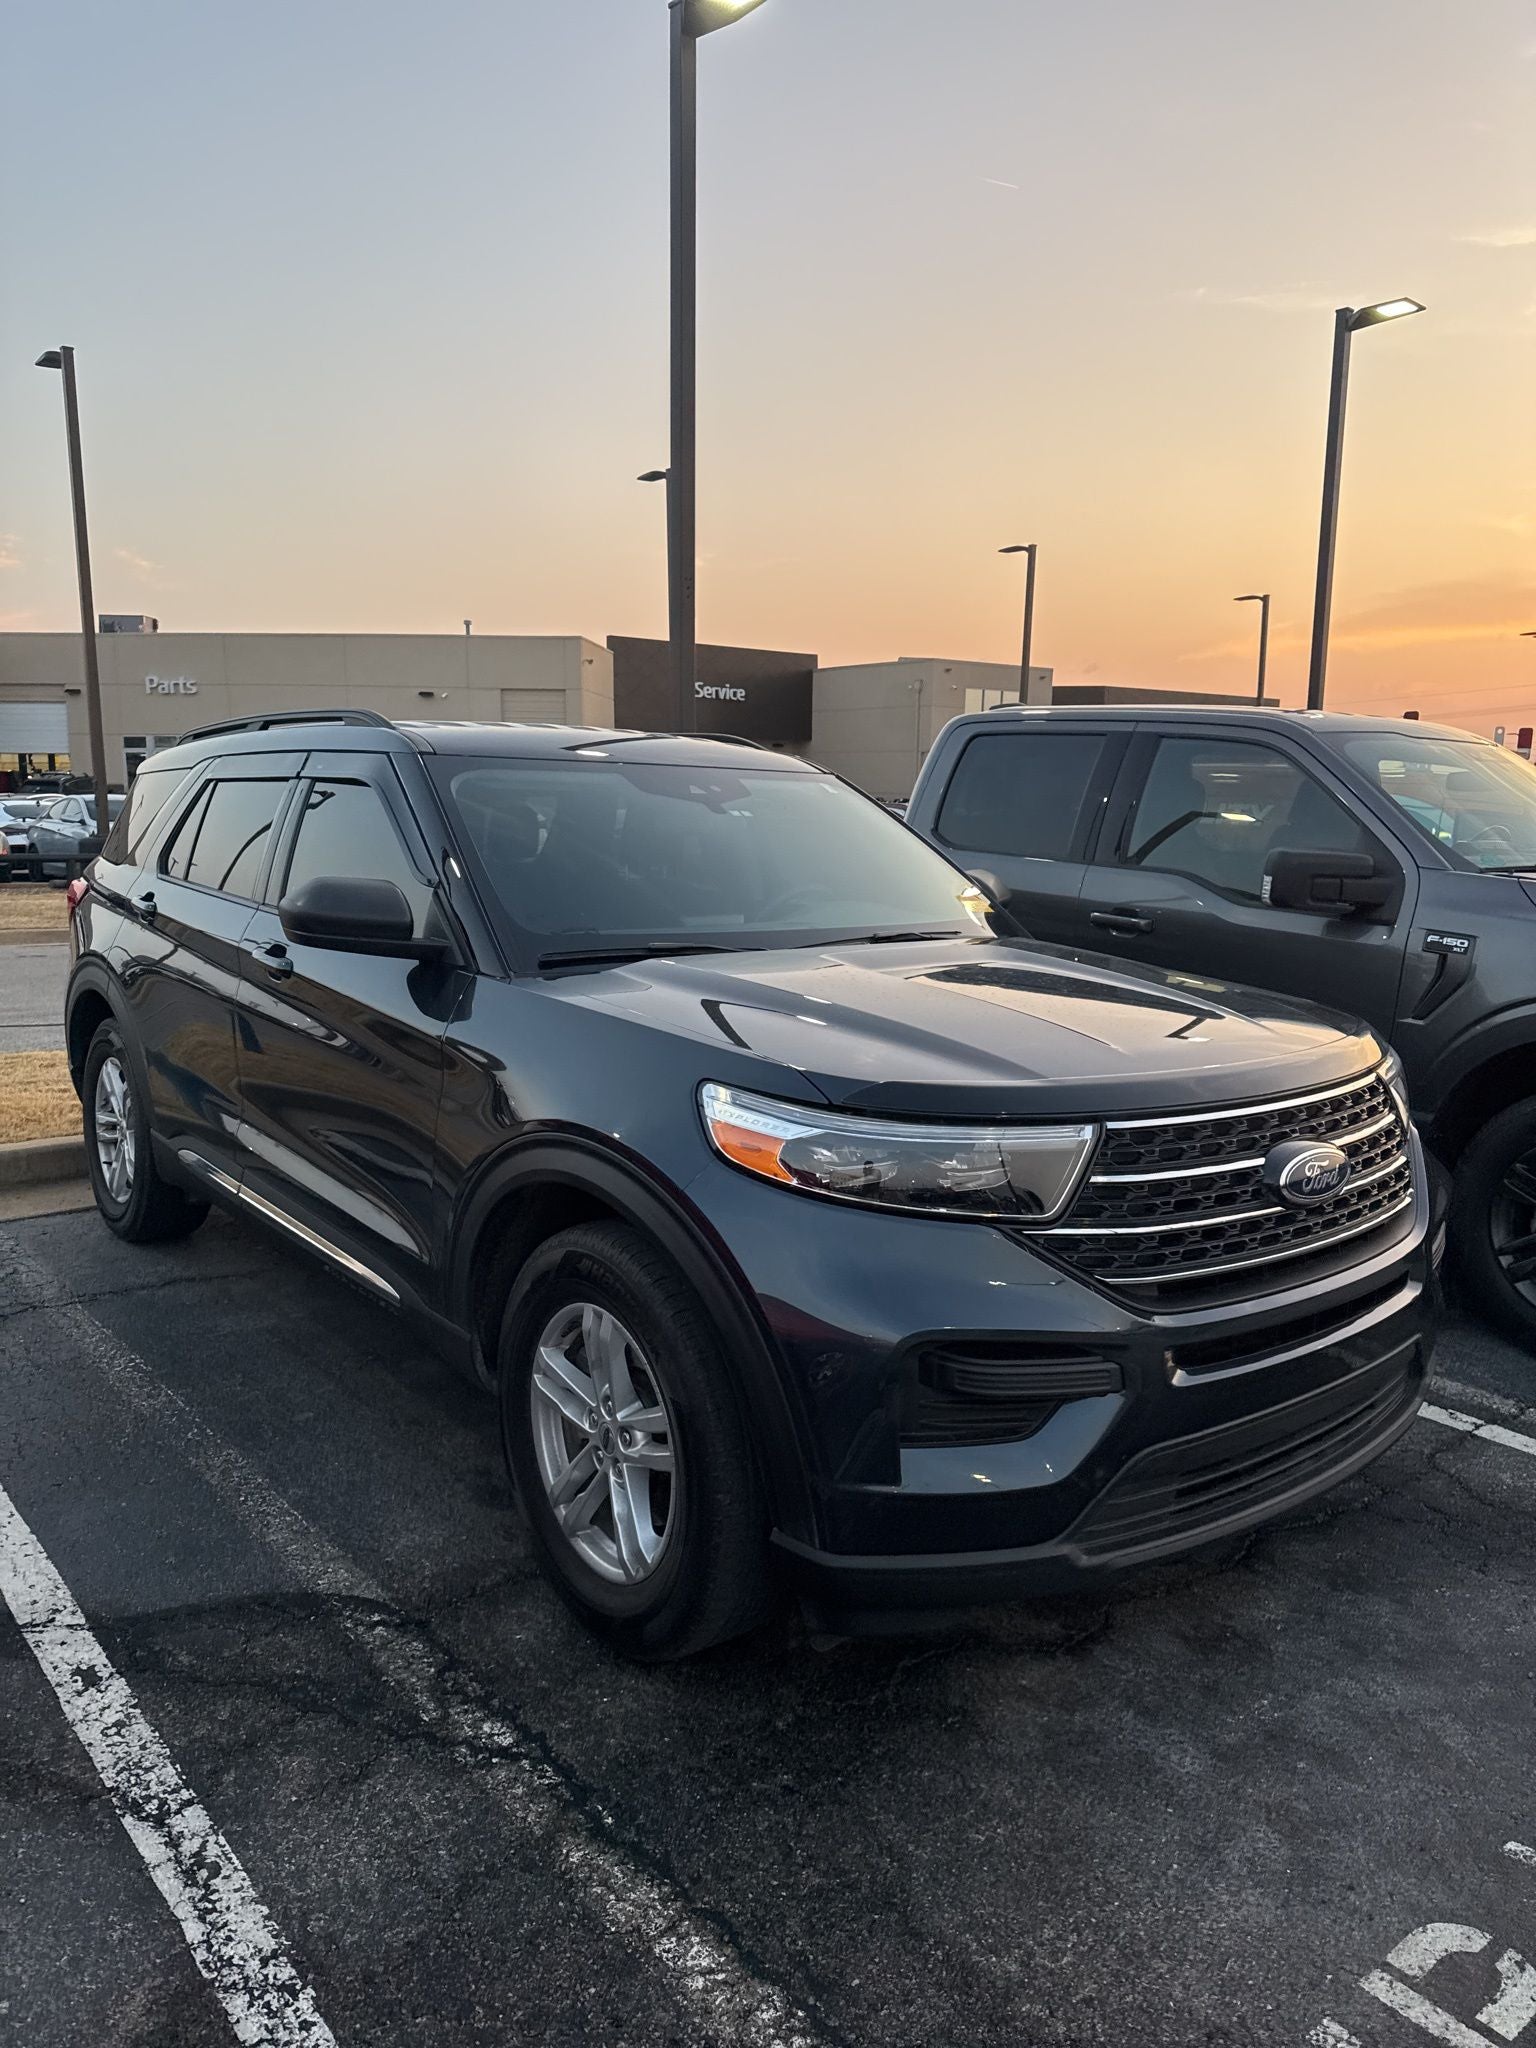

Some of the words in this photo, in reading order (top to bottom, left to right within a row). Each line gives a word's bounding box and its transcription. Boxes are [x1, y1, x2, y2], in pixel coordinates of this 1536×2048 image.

[145, 675, 198, 695] Parts
[694, 681, 746, 701] Service
[1426, 934, 1469, 948] F-150
[1302, 1159, 1340, 1193] Ford
